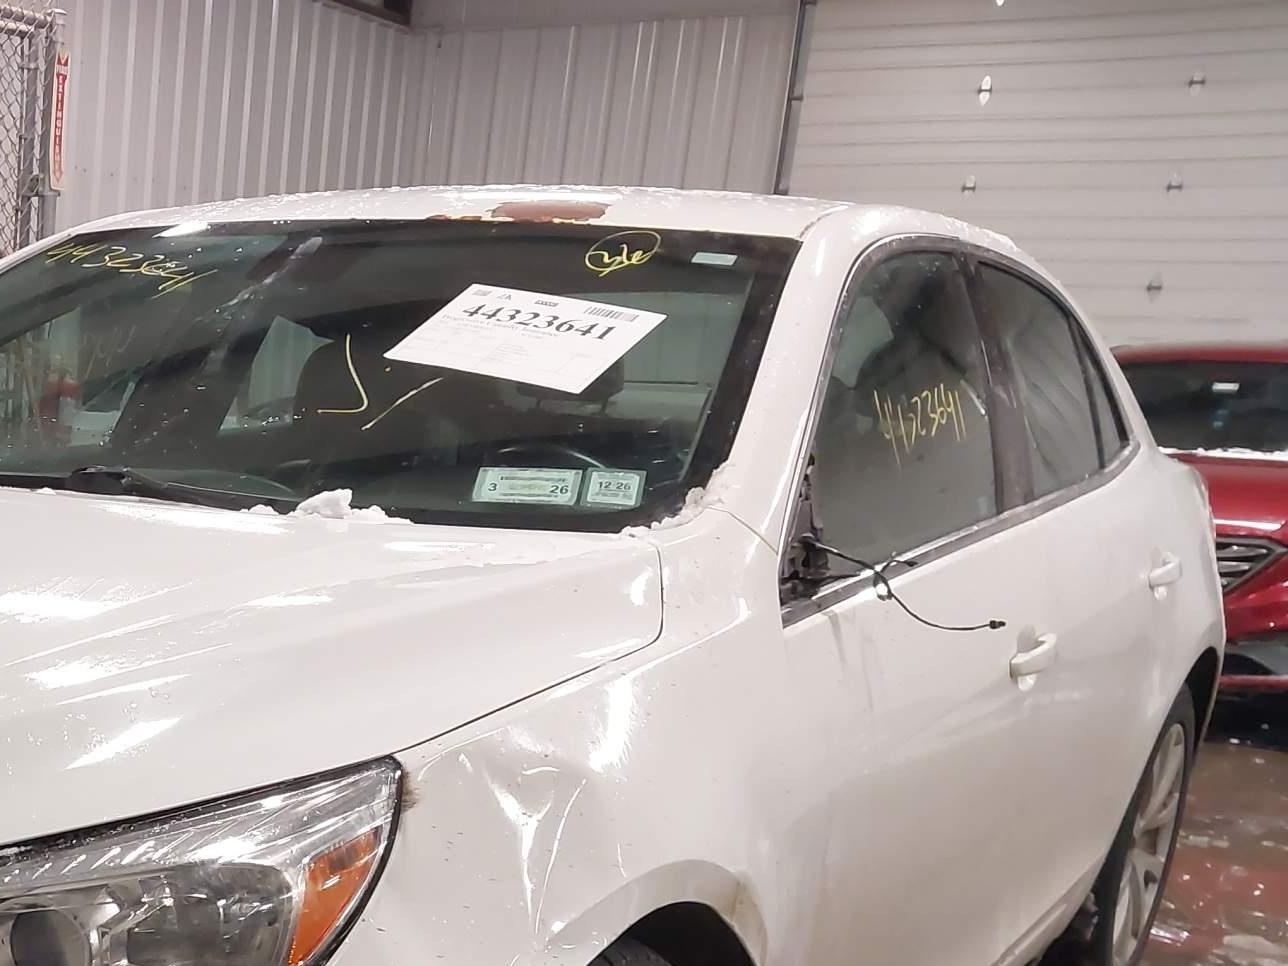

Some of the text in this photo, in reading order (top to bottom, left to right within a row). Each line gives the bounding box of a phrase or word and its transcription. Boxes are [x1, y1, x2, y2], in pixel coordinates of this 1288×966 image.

[54, 75, 64, 178] EXTINGUISH
[462, 303, 617, 341] 44323641
[488, 482, 569, 495] 3 26
